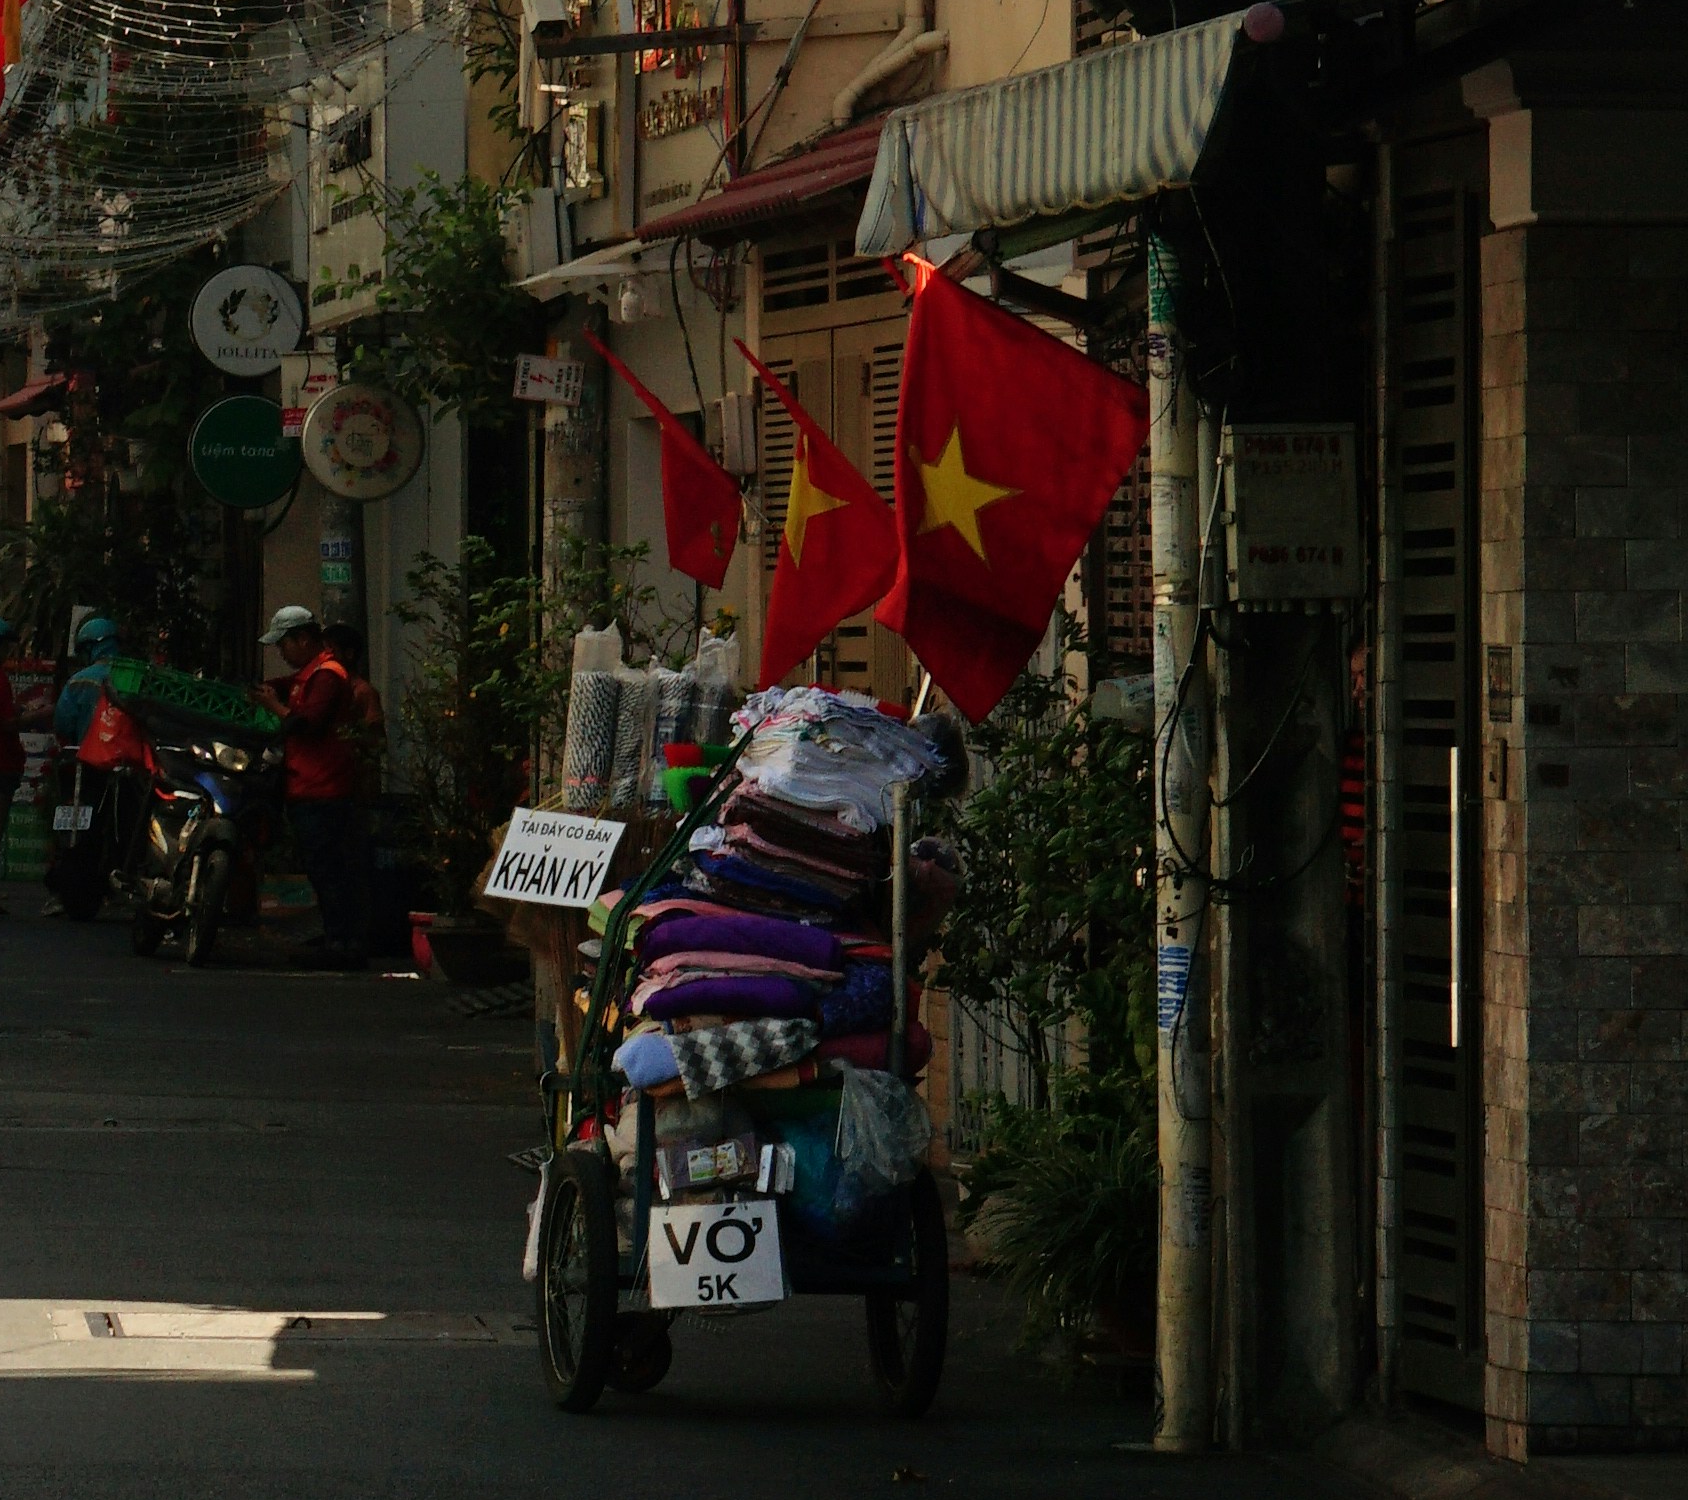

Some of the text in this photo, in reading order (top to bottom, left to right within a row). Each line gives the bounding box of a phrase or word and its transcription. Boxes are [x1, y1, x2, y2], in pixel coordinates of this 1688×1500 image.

[520, 820, 612, 843] TẠI ĐÂY CÓ BÁN
[493, 844, 605, 900] KHĂN KÝ
[663, 1207, 763, 1265] VỚ
[698, 1273, 740, 1302] 5K
